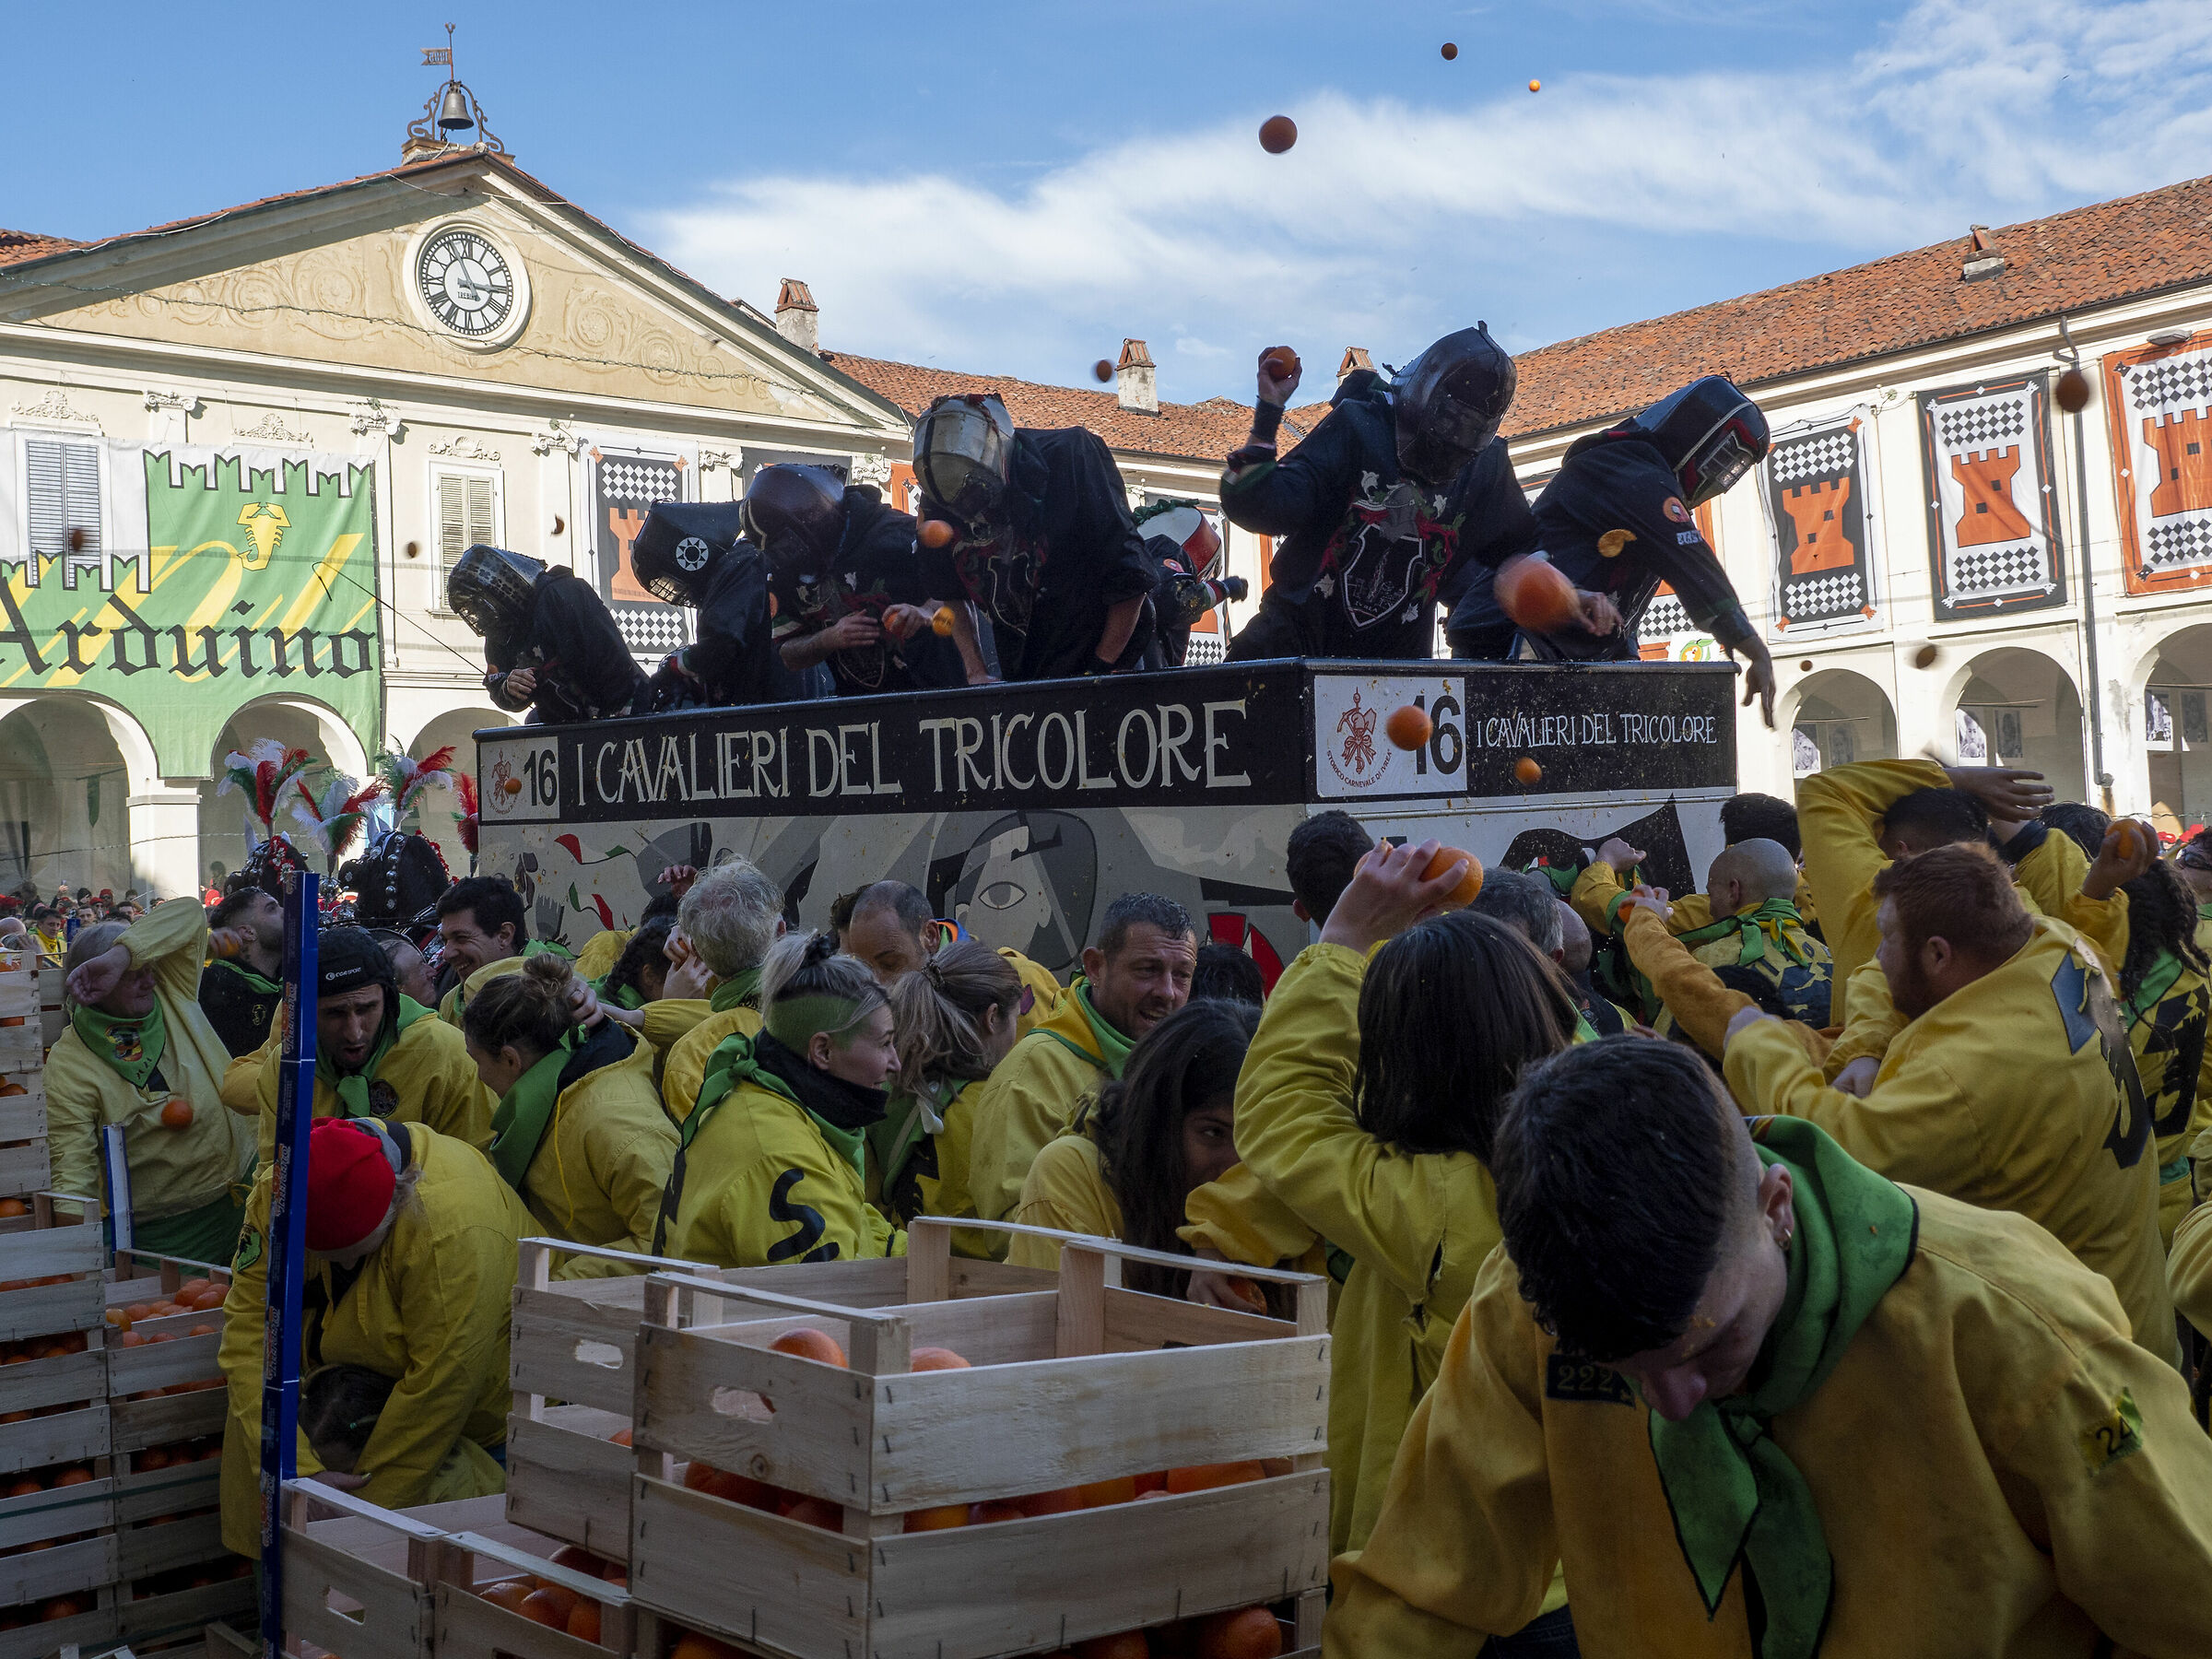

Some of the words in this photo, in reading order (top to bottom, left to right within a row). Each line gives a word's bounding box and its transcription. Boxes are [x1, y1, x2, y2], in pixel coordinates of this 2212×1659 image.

[576, 743, 586, 806] I
[596, 726, 791, 804] CAVALIERI
[806, 719, 903, 799] DEL
[919, 698, 1252, 794] TRICOLORE
[1412, 695, 1463, 774] 16
[1477, 721, 1483, 747] I
[1486, 712, 1576, 748] CAVALIERI
[1582, 713, 1616, 745] DEL
[1619, 713, 1717, 744] TRICOLORE
[524, 748, 558, 806] 16
[1326, 749, 1345, 780] STORICO
[1344, 776, 1376, 788] CARNEVALE
